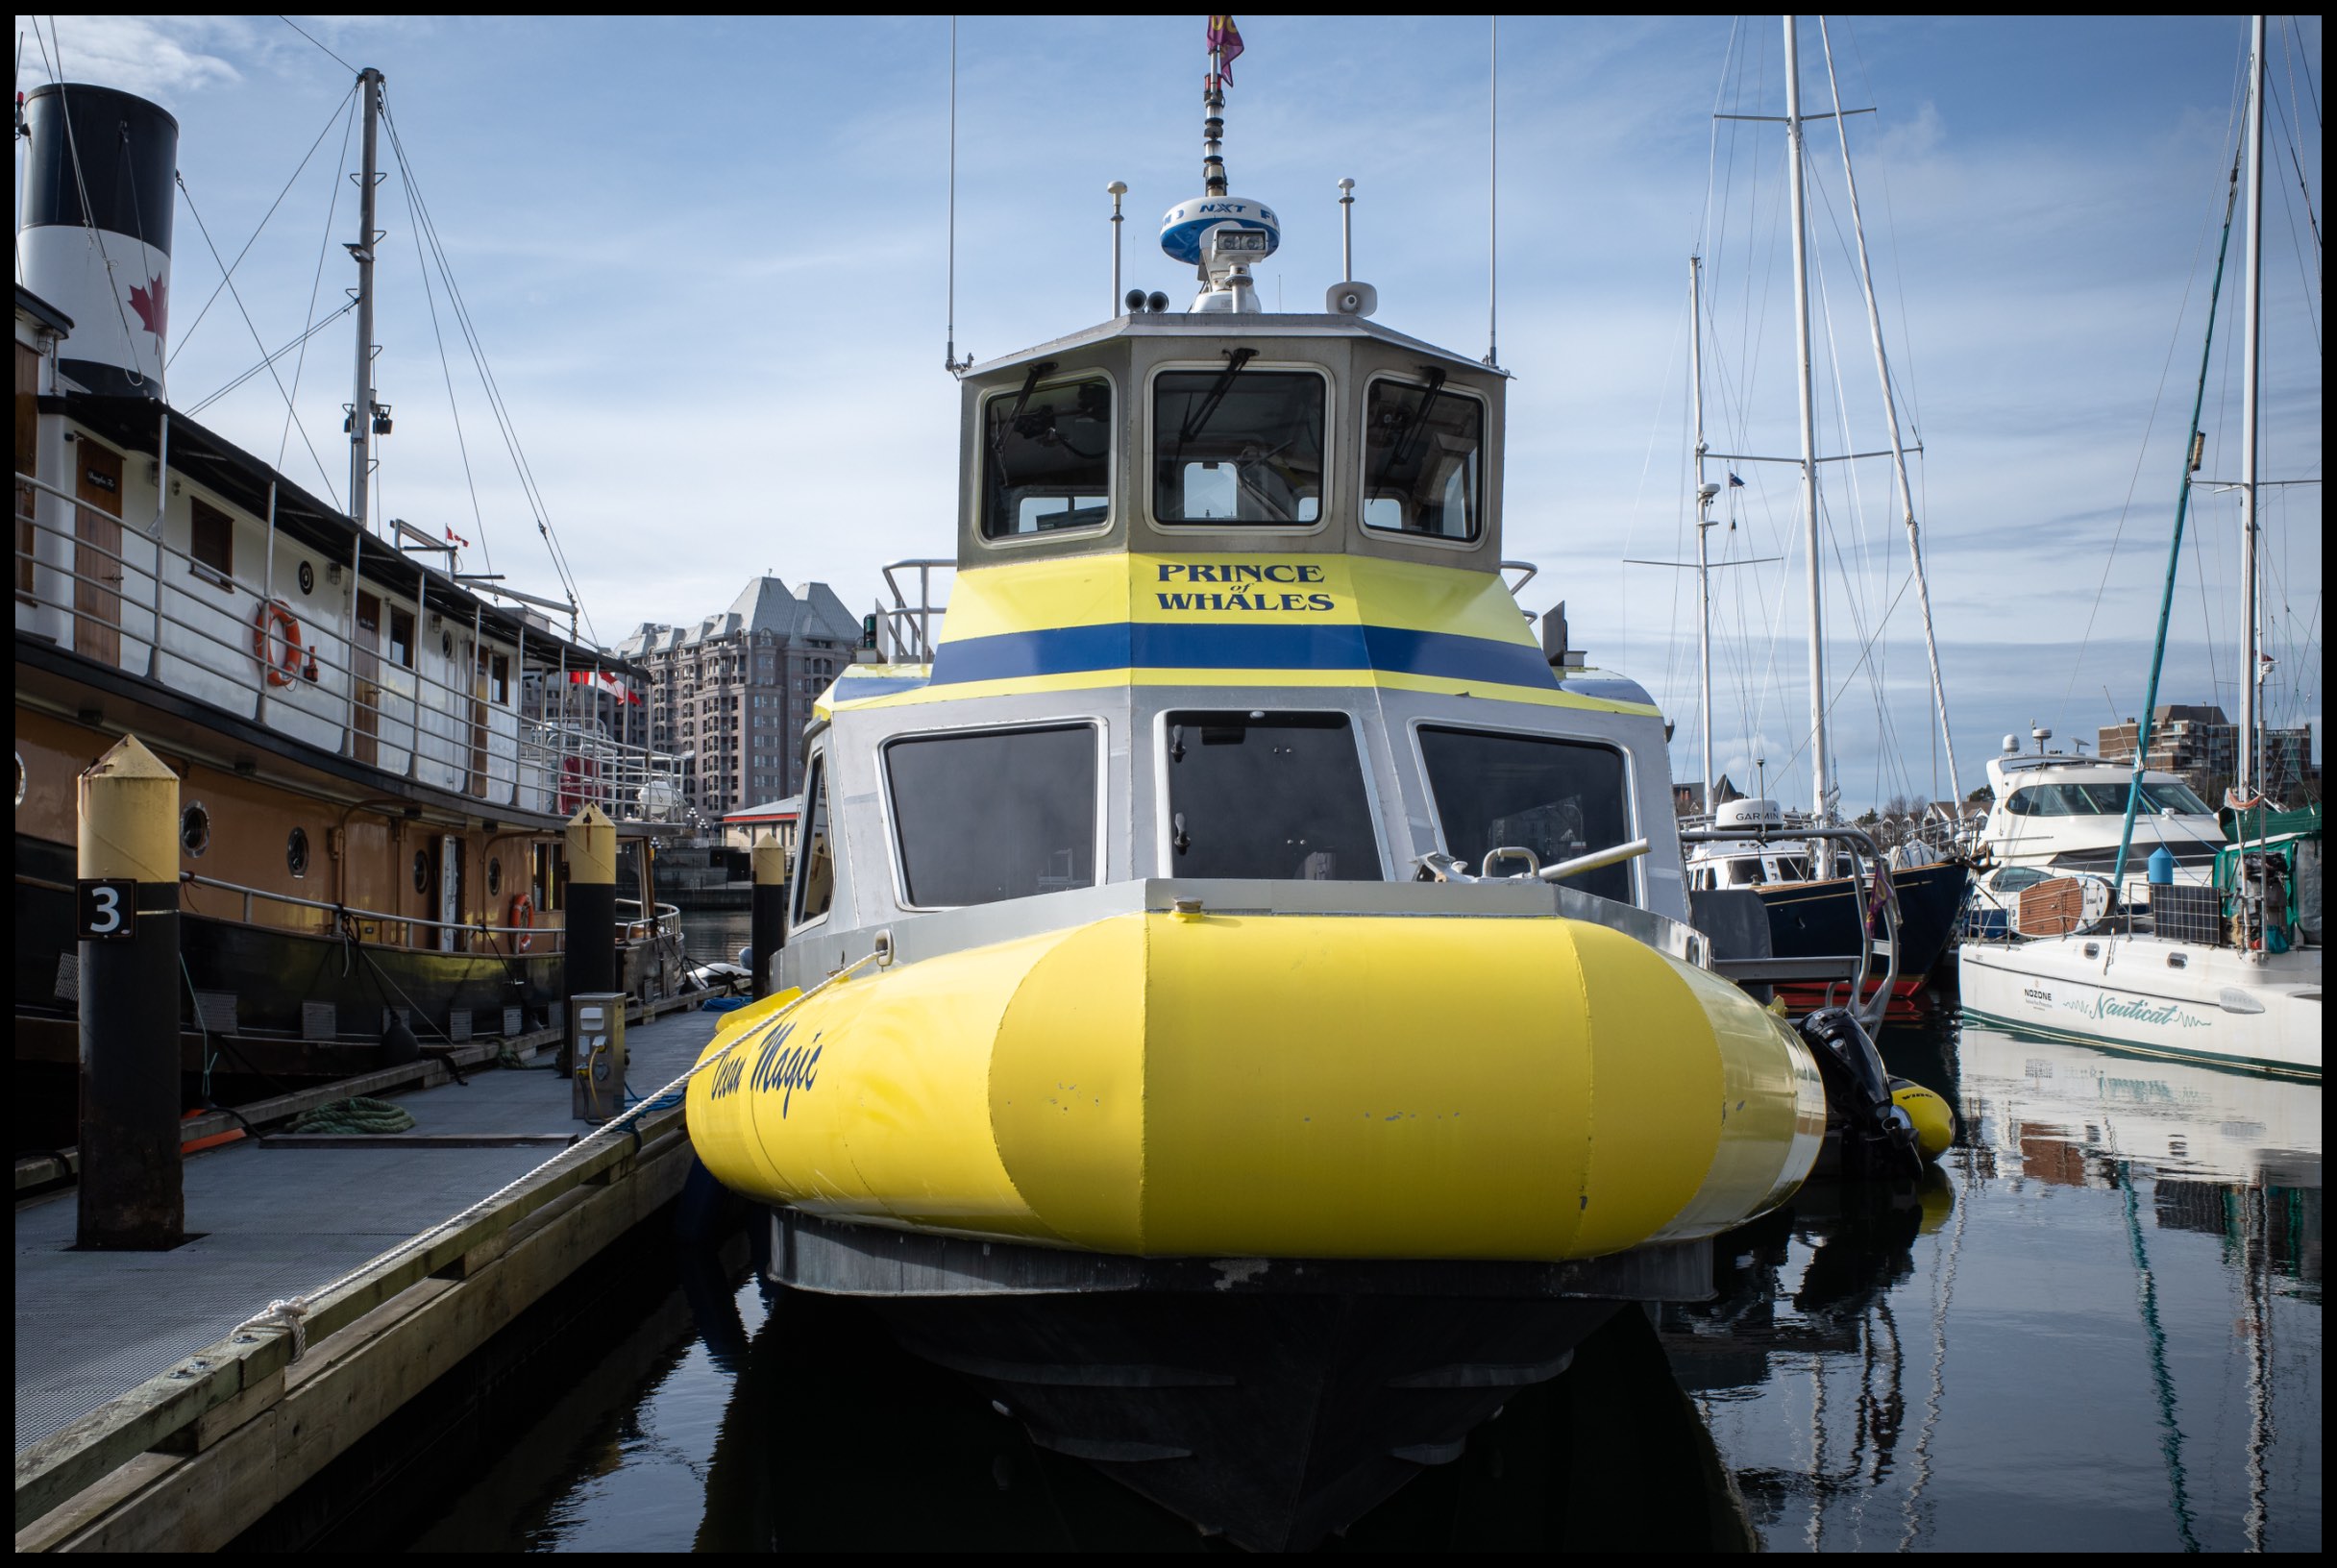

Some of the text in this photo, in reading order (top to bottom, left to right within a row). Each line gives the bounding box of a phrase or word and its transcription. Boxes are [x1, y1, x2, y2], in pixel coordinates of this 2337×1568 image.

[1199, 203, 1246, 212] NXT
[1157, 565, 1325, 583] PRINCE
[1230, 582, 1254, 594] of
[1156, 593, 1335, 611] WHALES
[90, 886, 120, 933] 3
[2024, 989, 2053, 1001] NOZONE
[2089, 992, 2175, 1024] Nauticat
[750, 1021, 823, 1119] Magic
